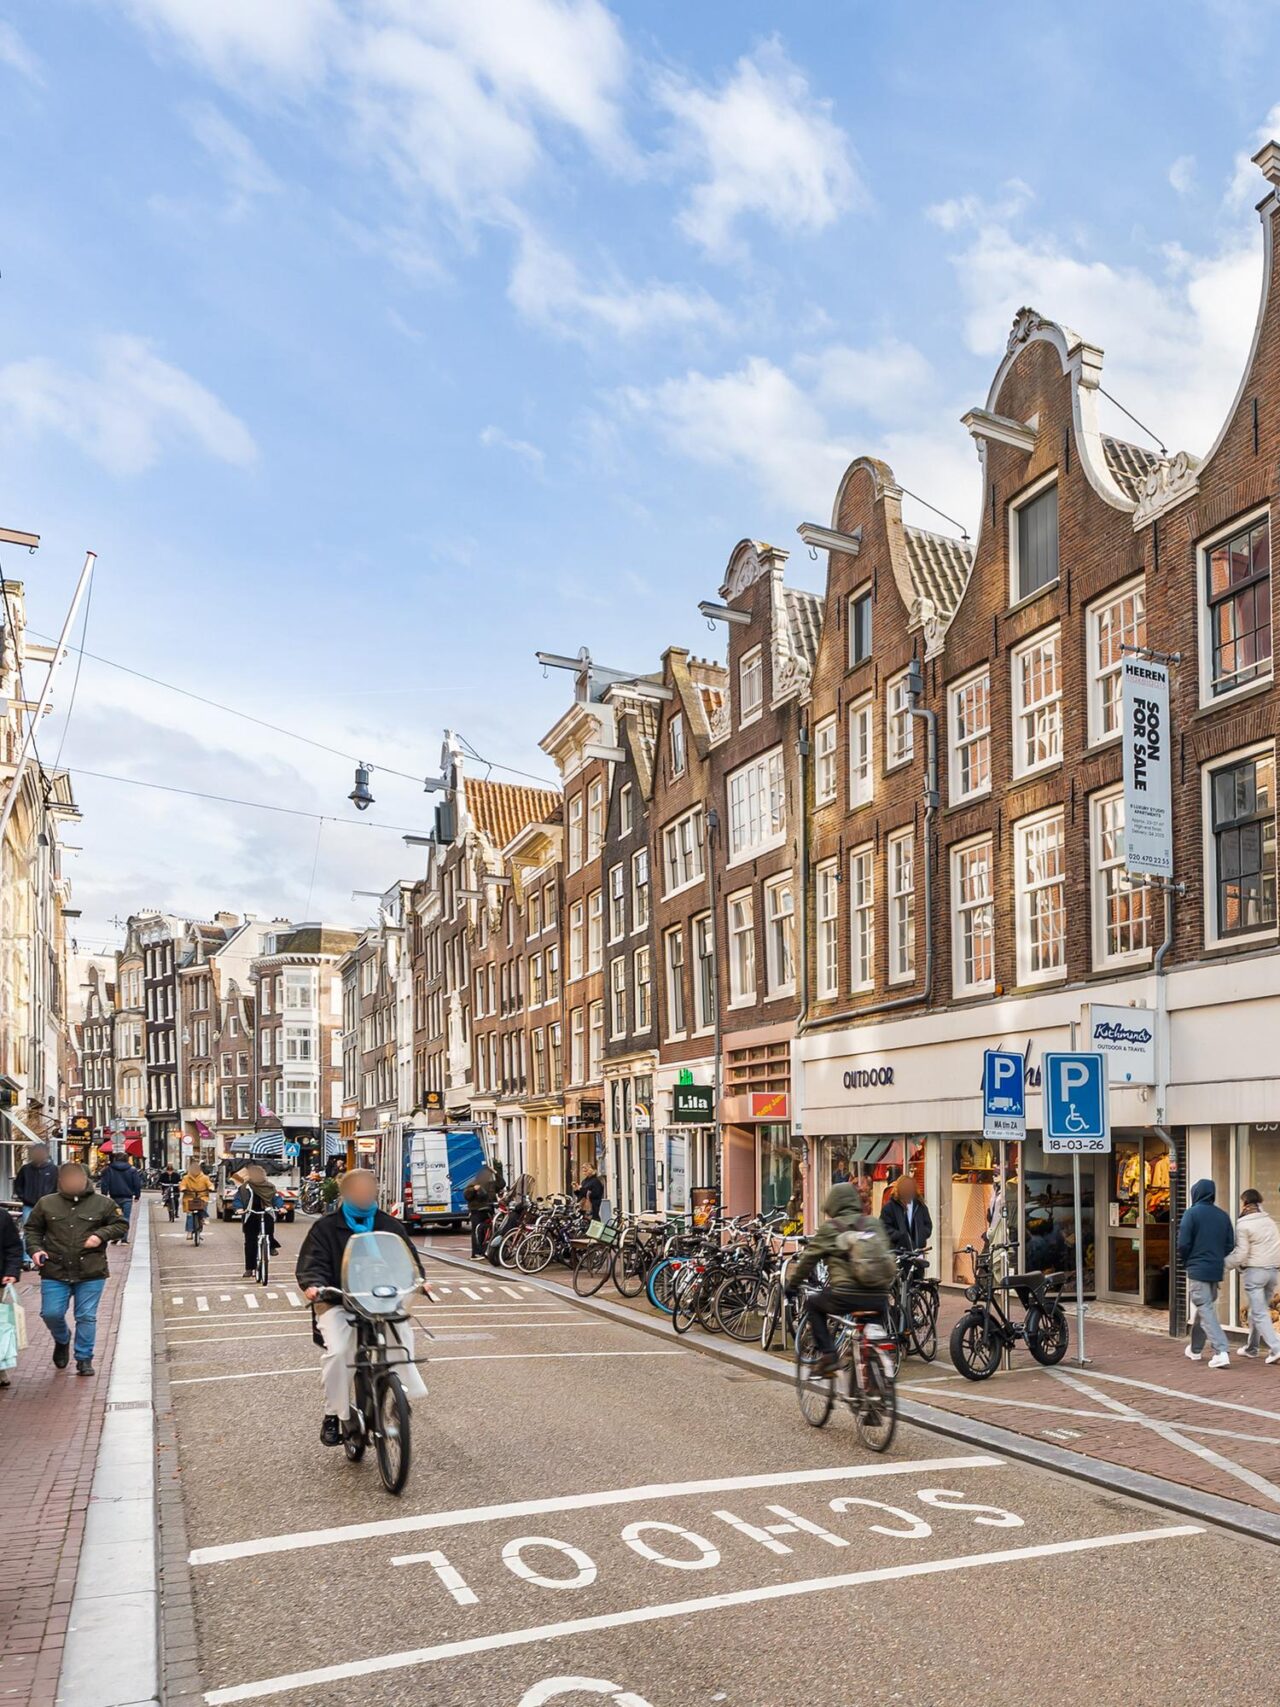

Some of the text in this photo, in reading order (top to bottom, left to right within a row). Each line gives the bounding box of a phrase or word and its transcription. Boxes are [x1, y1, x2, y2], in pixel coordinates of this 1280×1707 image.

[1125, 664, 1166, 683] HEEREN
[1147, 701, 1160, 761] SOON
[1133, 697, 1147, 791] FOR SALE
[1134, 809, 1161, 818] APARTMENTS
[1128, 853, 1140, 861] 020
[1142, 855, 1153, 863] 470
[843, 1066, 894, 1089] OUTDOOR
[995, 1057, 1016, 1089] P
[1060, 1062, 1090, 1102] P
[678, 1095, 708, 1109] Lila
[994, 1120, 1002, 1128] MA
[1010, 1121, 1018, 1129] ZA
[1049, 1140, 1105, 1150] 18-03-26
[390, 1488, 1025, 1605] SCHOOL
